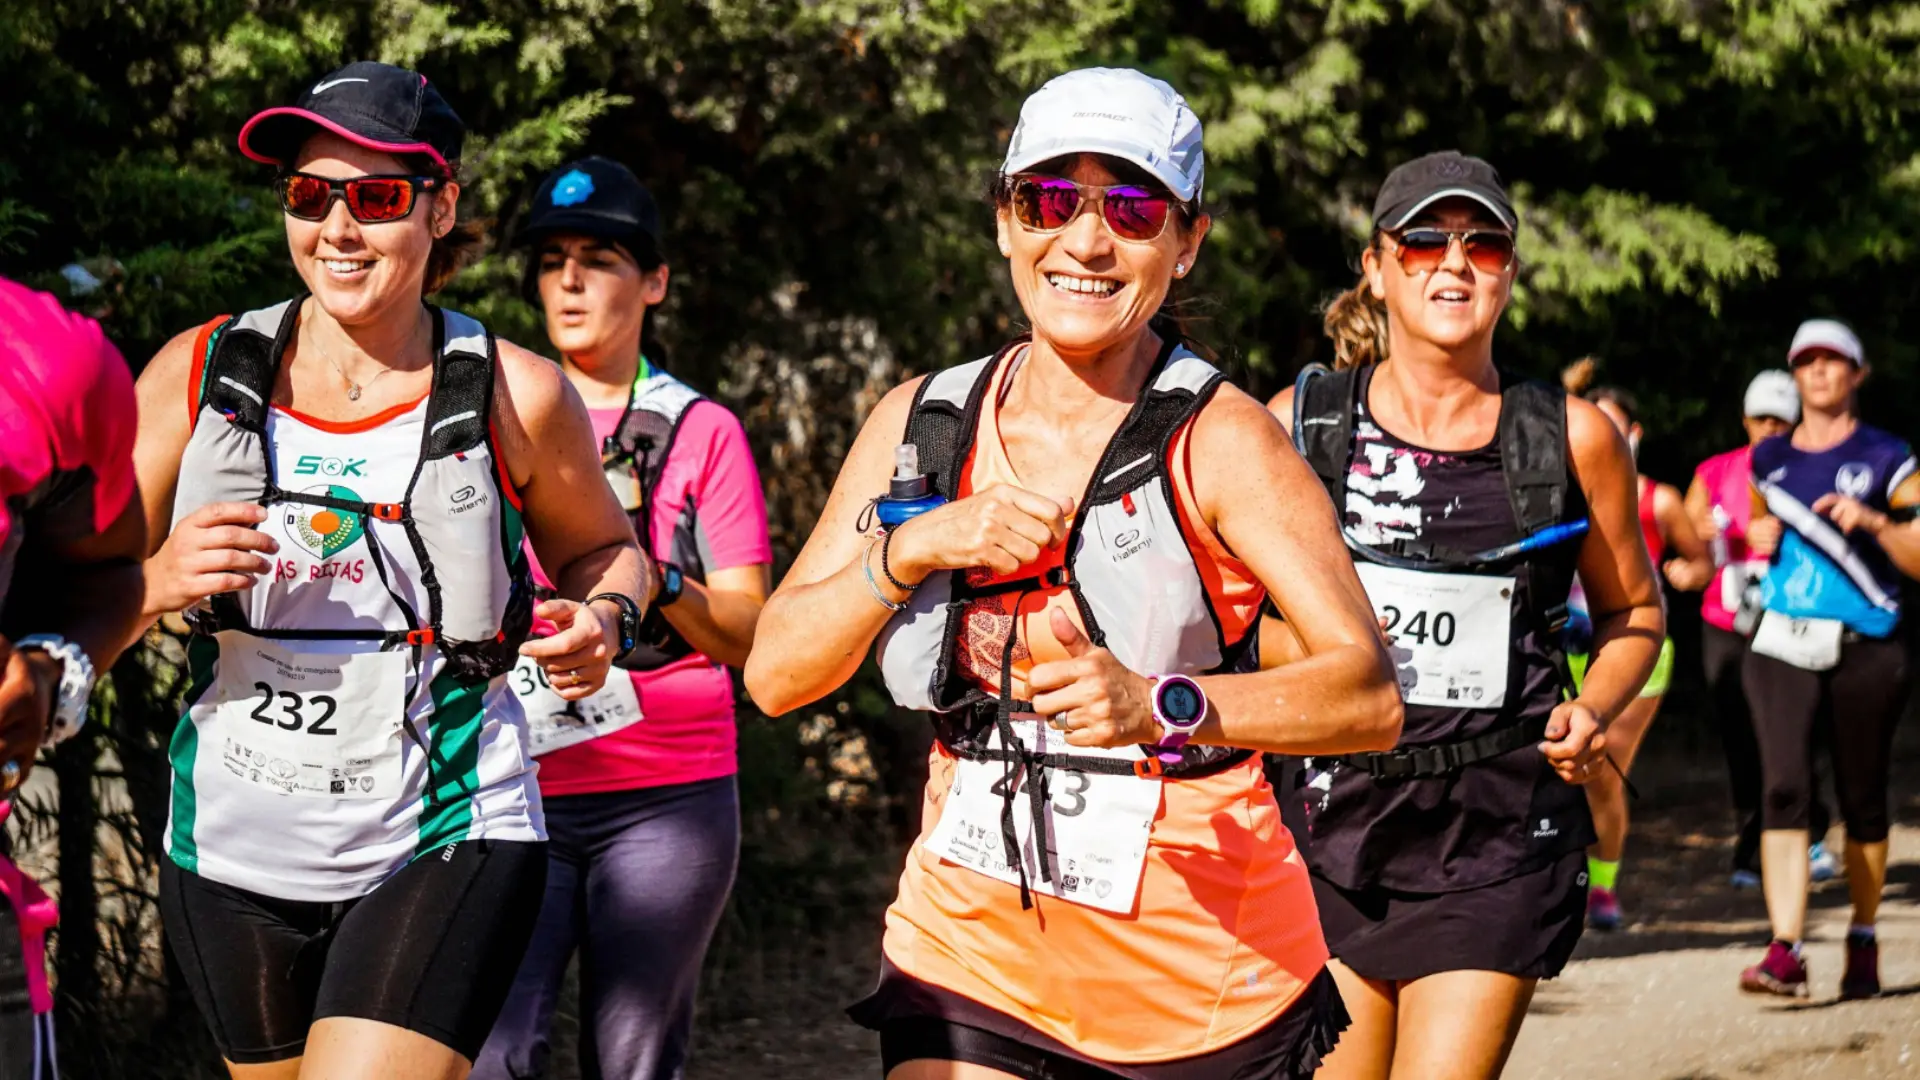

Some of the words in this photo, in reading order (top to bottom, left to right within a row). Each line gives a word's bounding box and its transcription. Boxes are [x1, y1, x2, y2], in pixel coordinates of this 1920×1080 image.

[309, 559, 365, 583] RIJAS
[1383, 605, 1456, 646] 240
[250, 681, 337, 735] 232
